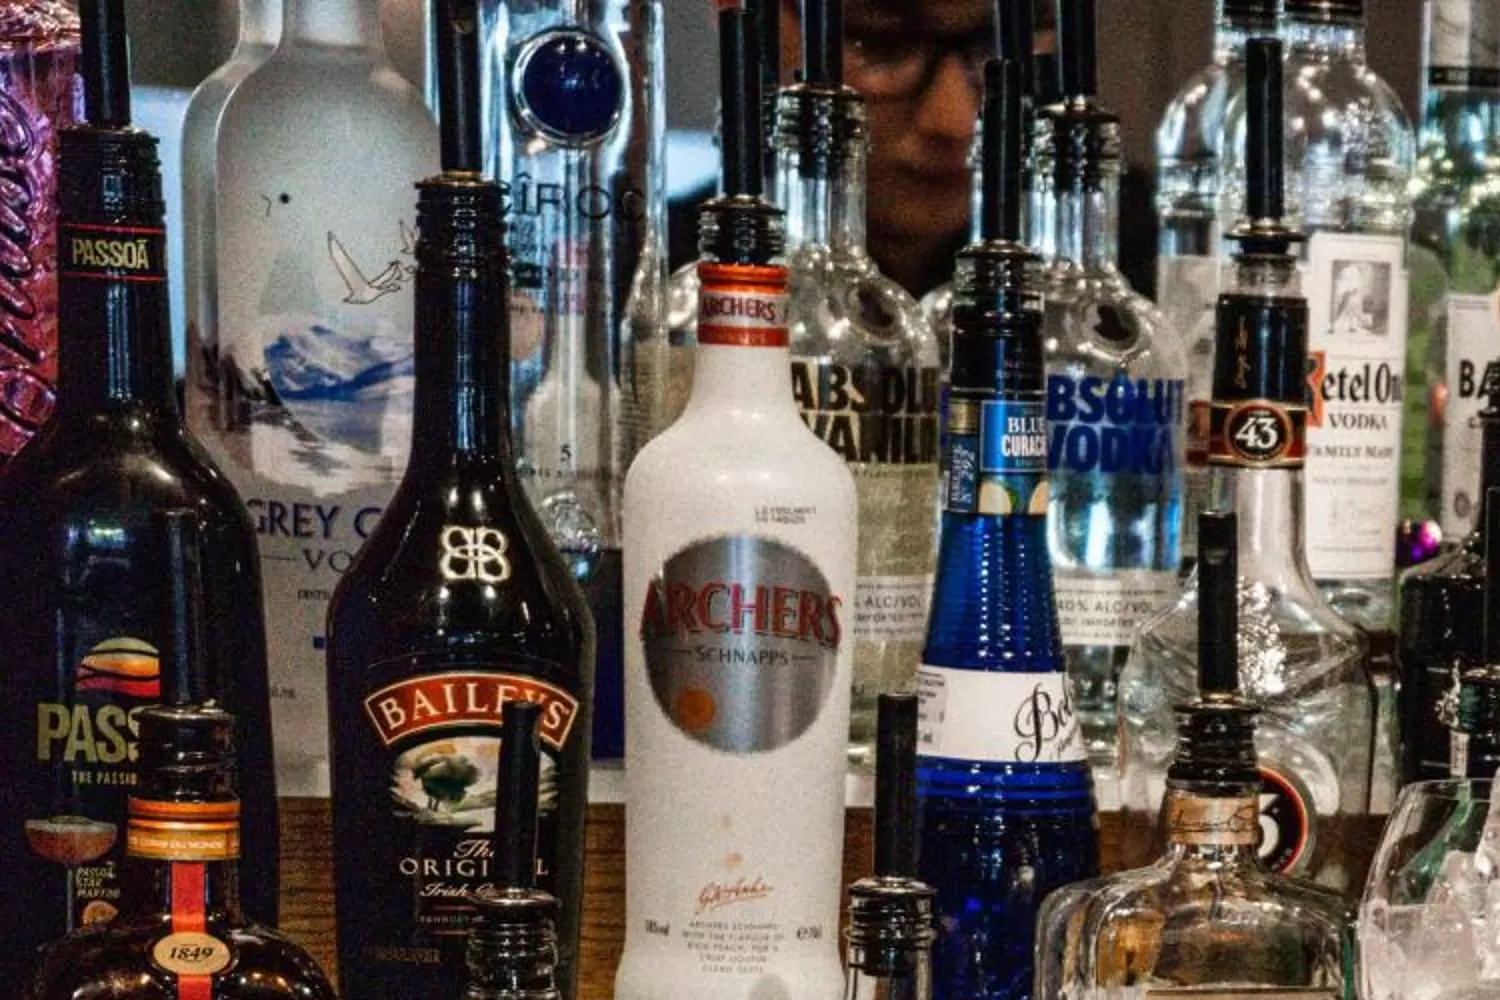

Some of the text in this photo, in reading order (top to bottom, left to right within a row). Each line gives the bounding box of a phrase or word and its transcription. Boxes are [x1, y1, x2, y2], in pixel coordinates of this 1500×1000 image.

[702, 296, 776, 321] ARCHERS
[1047, 375, 1184, 425] BSOLUT
[1236, 417, 1278, 449] 43
[639, 579, 844, 648] ARCHERS
[695, 646, 790, 666] SCHNAPPS
[36, 701, 141, 763] PAS
[96, 771, 138, 786] PASSIO
[399, 858, 549, 877] ORIGIL
[169, 946, 214, 961] 1849
